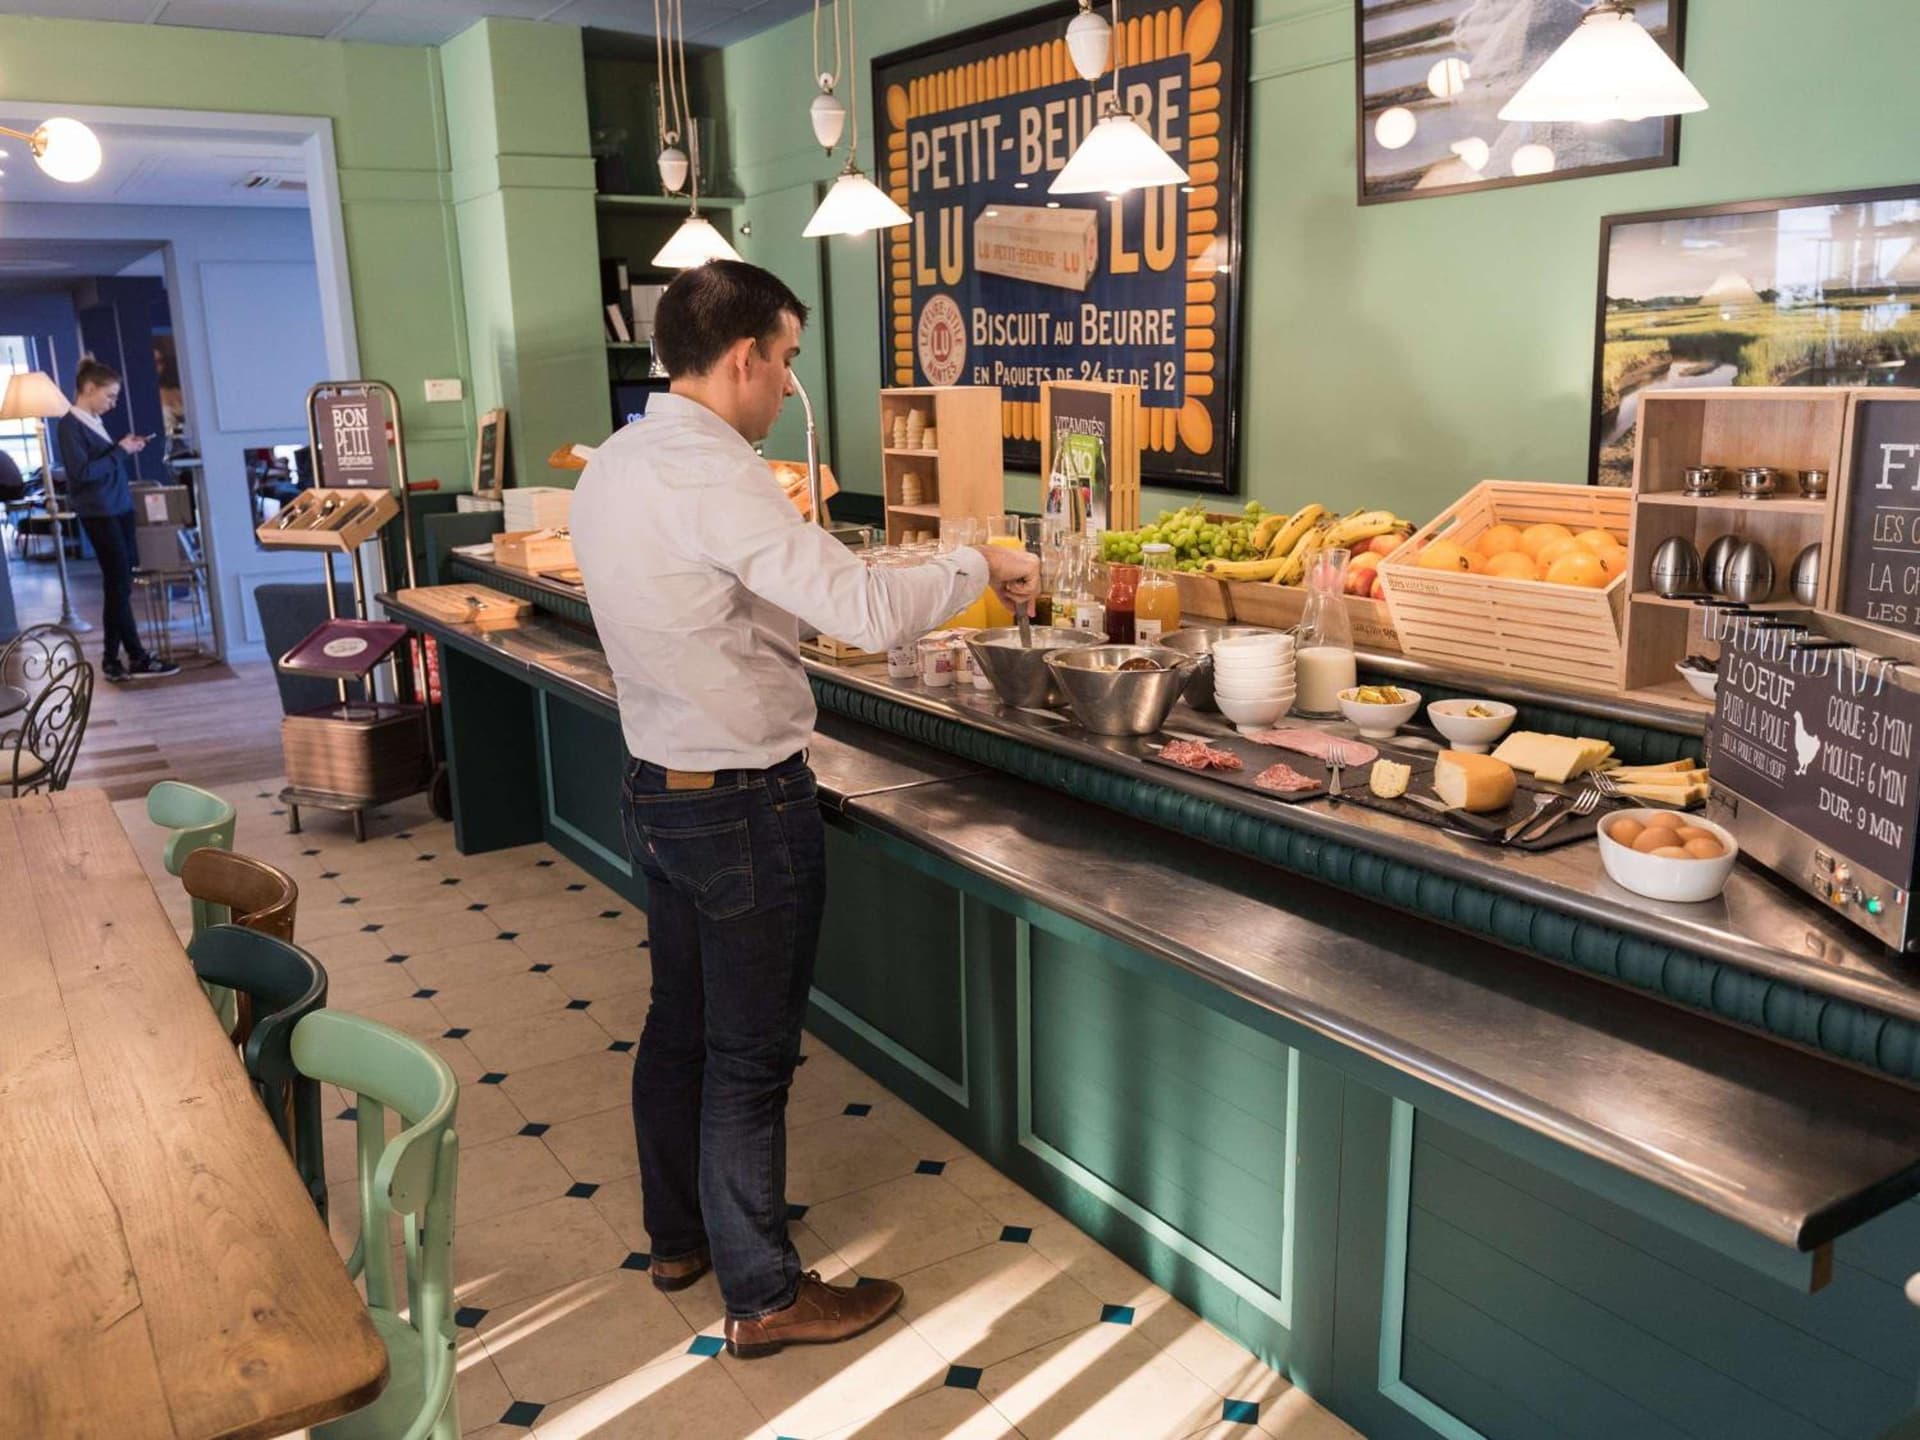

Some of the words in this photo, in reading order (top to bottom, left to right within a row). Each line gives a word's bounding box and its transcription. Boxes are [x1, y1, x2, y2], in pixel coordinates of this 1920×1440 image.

[914, 206, 963, 286] LU
[1110, 184, 1177, 274] LU
[1063, 250, 1080, 273] LU
[933, 328, 951, 356] LU
[972, 307, 1050, 347] BISCUIT
[1055, 321, 1074, 344] AU
[1081, 304, 1176, 346] BEURRE
[973, 366, 989, 385] EN
[995, 360, 1052, 388] PAQUETS
[1056, 367, 1074, 381] DE
[1107, 368, 1124, 384] ET
[1129, 369, 1149, 390] DE
[1154, 361, 1176, 391] 12
[332, 408, 368, 428] BON
[335, 427, 371, 456] PETIT
[1875, 443, 1920, 491] F
[1873, 513, 1904, 543] LES
[1869, 562, 1893, 593] LA
[1866, 601, 1908, 623] LES
[1726, 652, 1796, 710] L'OEUF
[1722, 690, 1744, 728] PUIS
[1744, 702, 1757, 737] LA
[1760, 709, 1789, 752] POULE
[1827, 696, 1866, 740] COQUE:
[1869, 711, 1879, 746] 3
[1881, 714, 1912, 759] MIN
[1822, 740, 1865, 787] MOLLET:
[1867, 762, 1876, 794] 6
[1878, 765, 1907, 807] MIN
[1818, 786, 1853, 823] DUR:
[1857, 807, 1867, 830] 9
[1869, 812, 1903, 849] MIN
